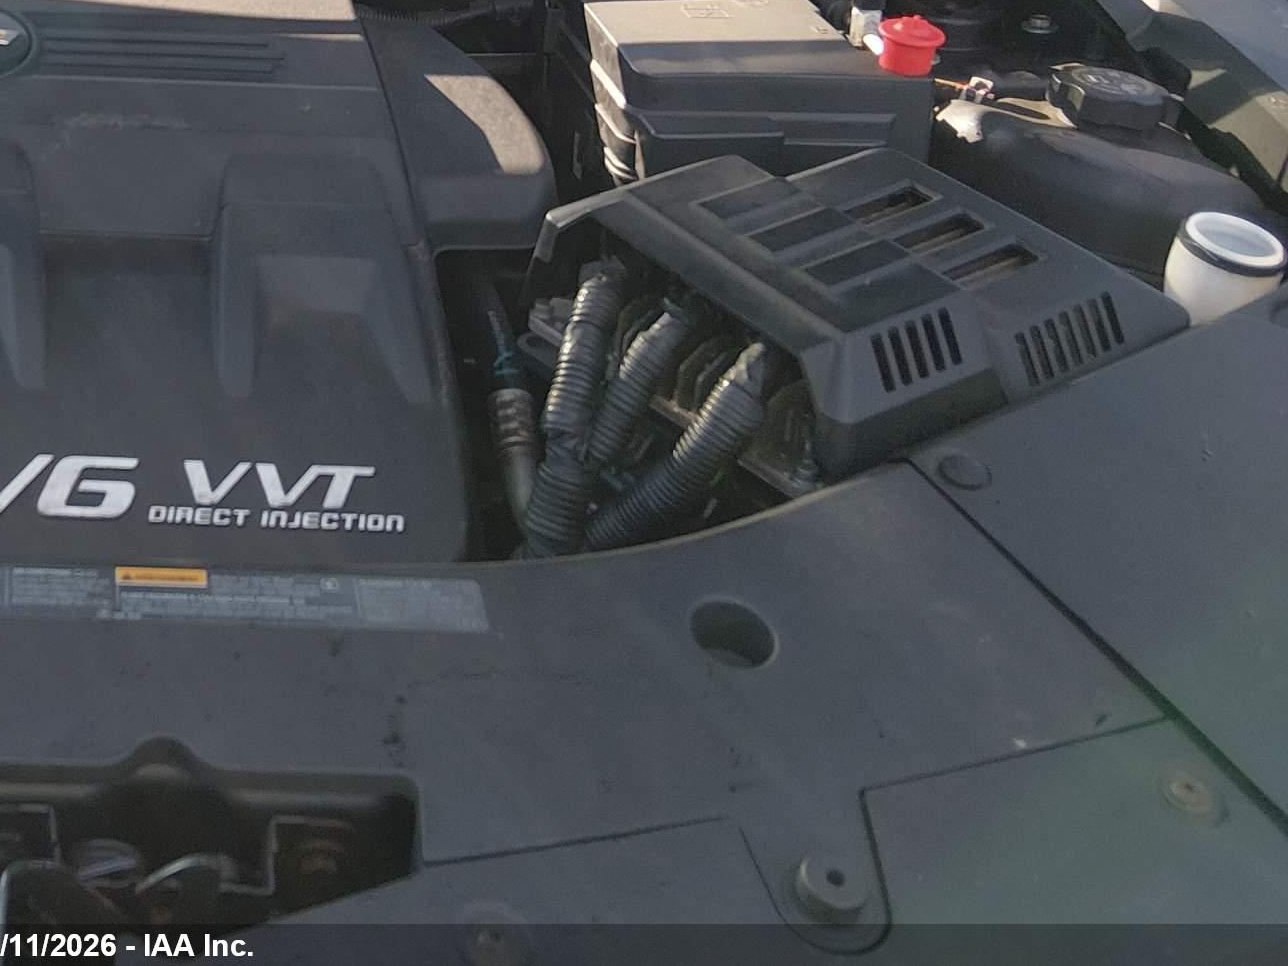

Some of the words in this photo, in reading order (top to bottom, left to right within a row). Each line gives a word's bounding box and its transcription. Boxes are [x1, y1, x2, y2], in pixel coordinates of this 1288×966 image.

[183, 459, 375, 509] VVT
[148, 505, 250, 527] DIRECT
[260, 510, 406, 533] INJECTION
